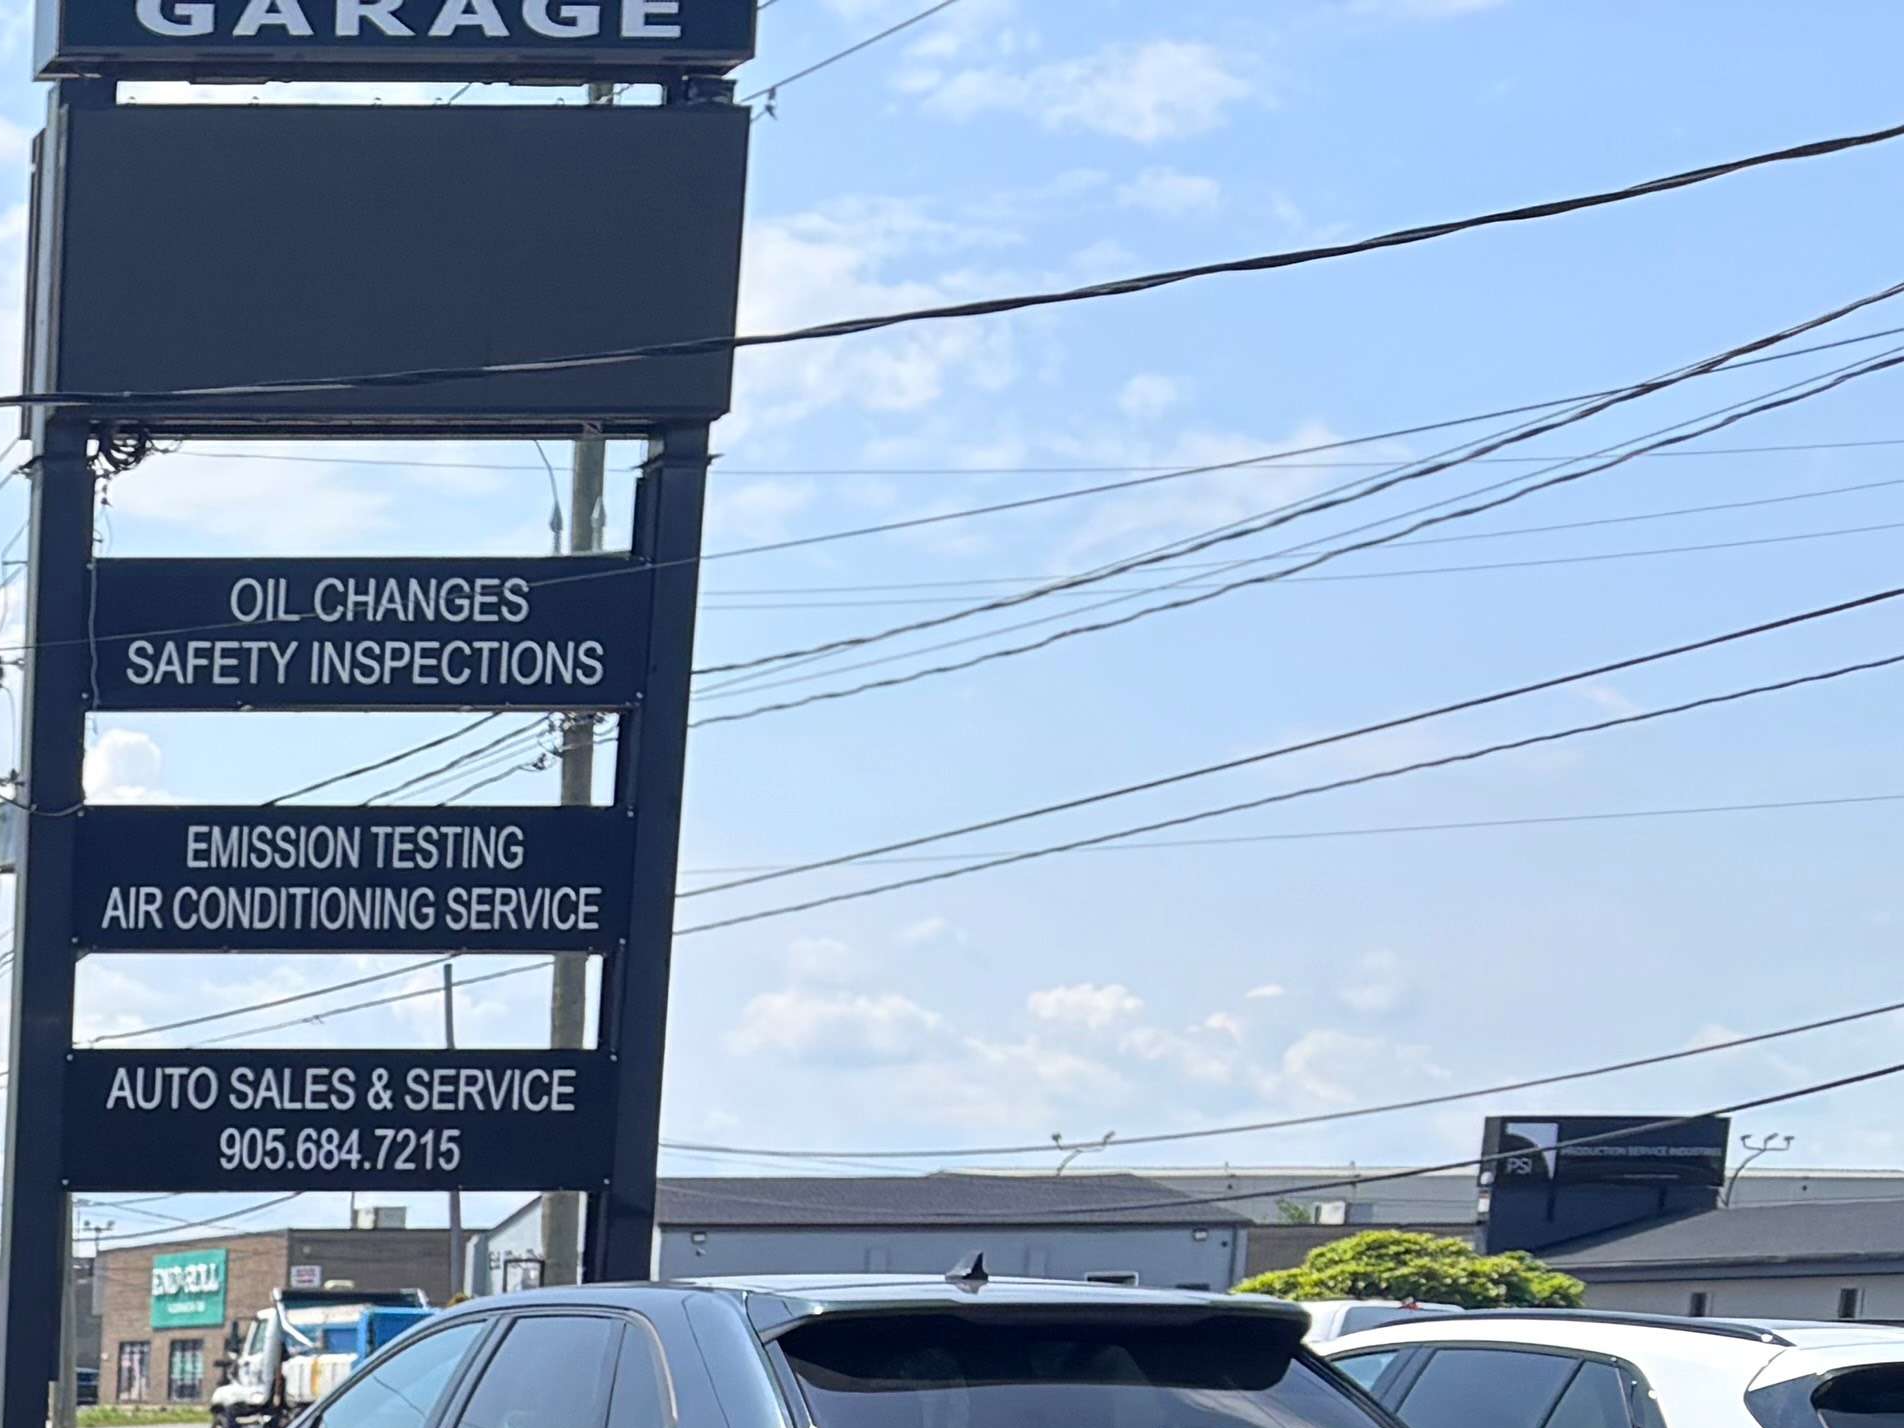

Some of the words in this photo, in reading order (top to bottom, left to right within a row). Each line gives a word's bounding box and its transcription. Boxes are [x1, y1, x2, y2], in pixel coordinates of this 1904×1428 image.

[135, 0, 682, 39] GARAGE
[230, 576, 301, 622] OIL
[313, 576, 530, 623] CHANGES
[126, 639, 299, 685] SAFETY
[310, 639, 604, 686] INSPECTIONS
[186, 826, 360, 869] EMISSION
[373, 826, 524, 870] TESTING
[103, 886, 161, 930] AIR
[173, 886, 435, 931] CONDITIONING
[444, 886, 601, 931] SERVICE
[106, 1067, 218, 1111] AUTO
[228, 1067, 356, 1111] SALES
[367, 1068, 394, 1111] &
[404, 1068, 576, 1112] SERVICE
[219, 1128, 460, 1171] 905.684.7215
[1505, 1158, 1532, 1174] PSI
